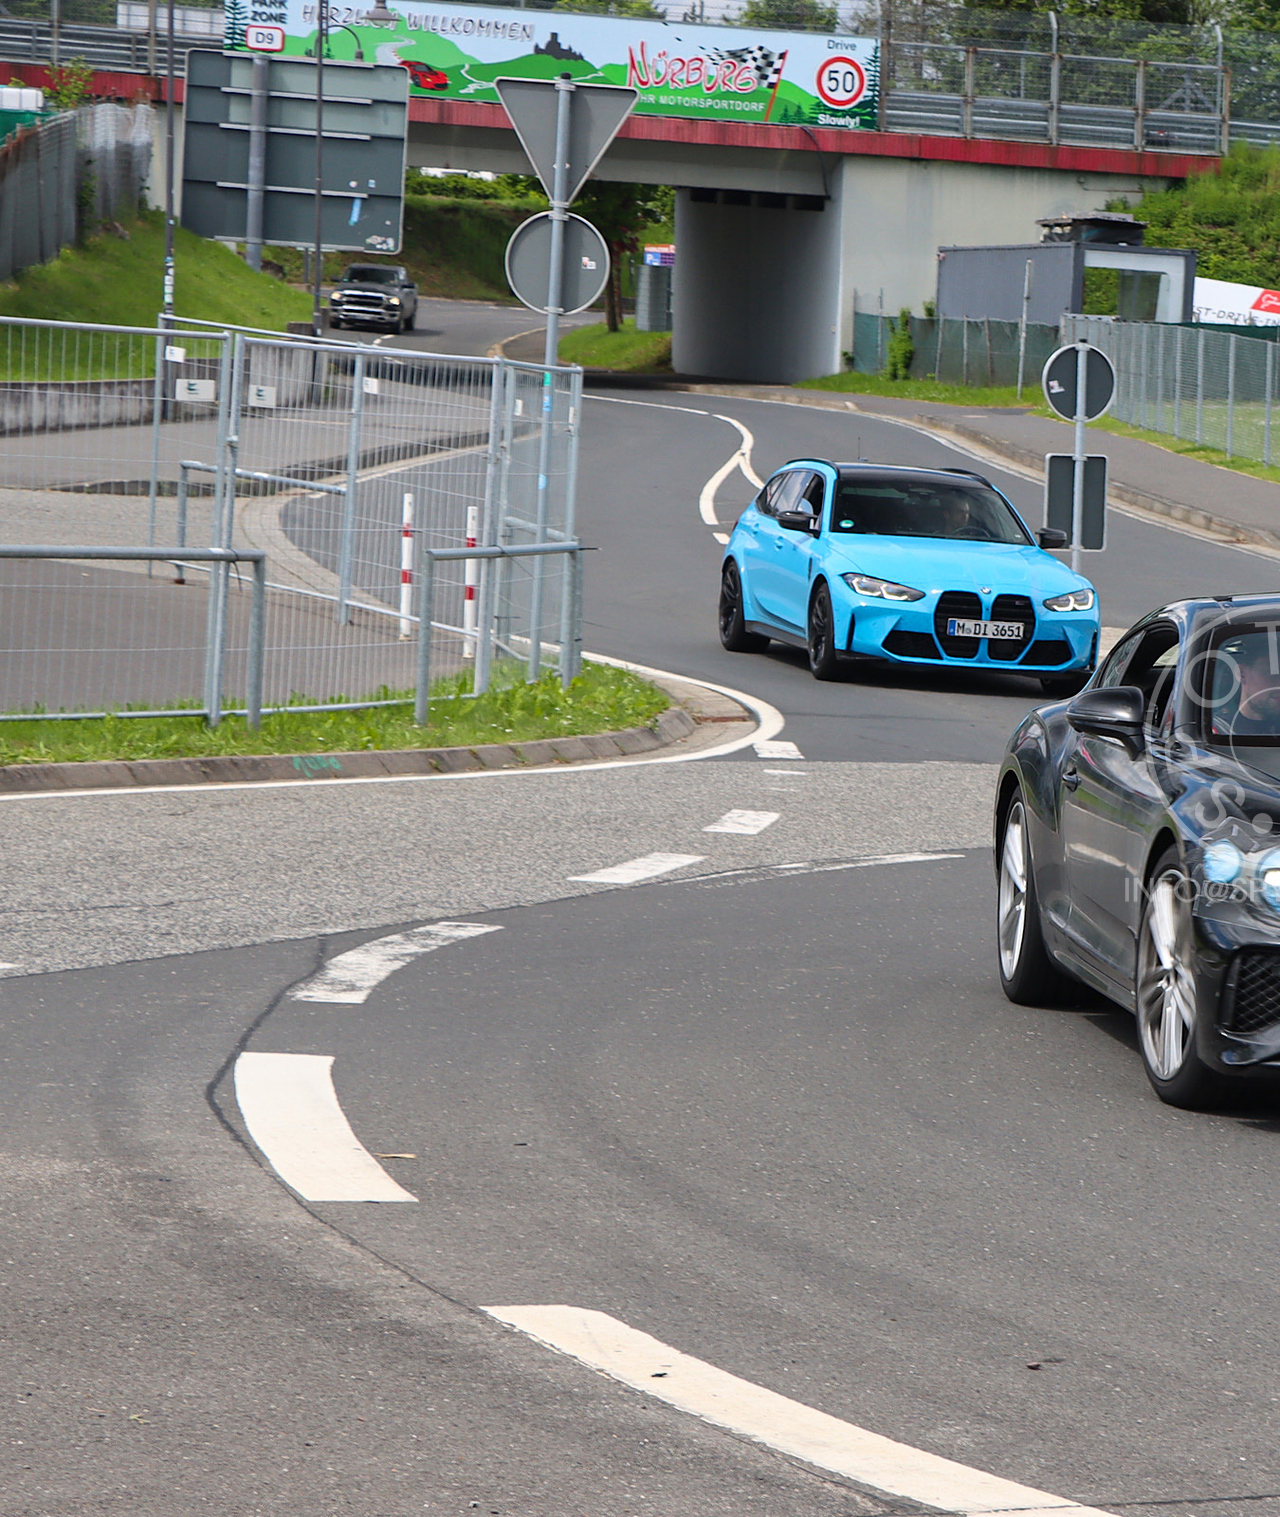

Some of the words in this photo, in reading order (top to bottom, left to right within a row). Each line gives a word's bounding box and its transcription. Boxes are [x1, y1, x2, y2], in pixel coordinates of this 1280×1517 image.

[251, 10, 288, 24] ZONE
[406, 12, 535, 41] WILLKOMMEN
[255, 31, 274, 44] D9
[827, 39, 857, 51] Drive
[627, 41, 759, 93] NÜRBURG
[827, 69, 855, 93] 50
[659, 94, 765, 112] MOTORSPORTDORF
[817, 113, 861, 129] Slowly!
[956, 622, 966, 634] M
[973, 623, 989, 636] DI
[992, 624, 1022, 638] 3651
